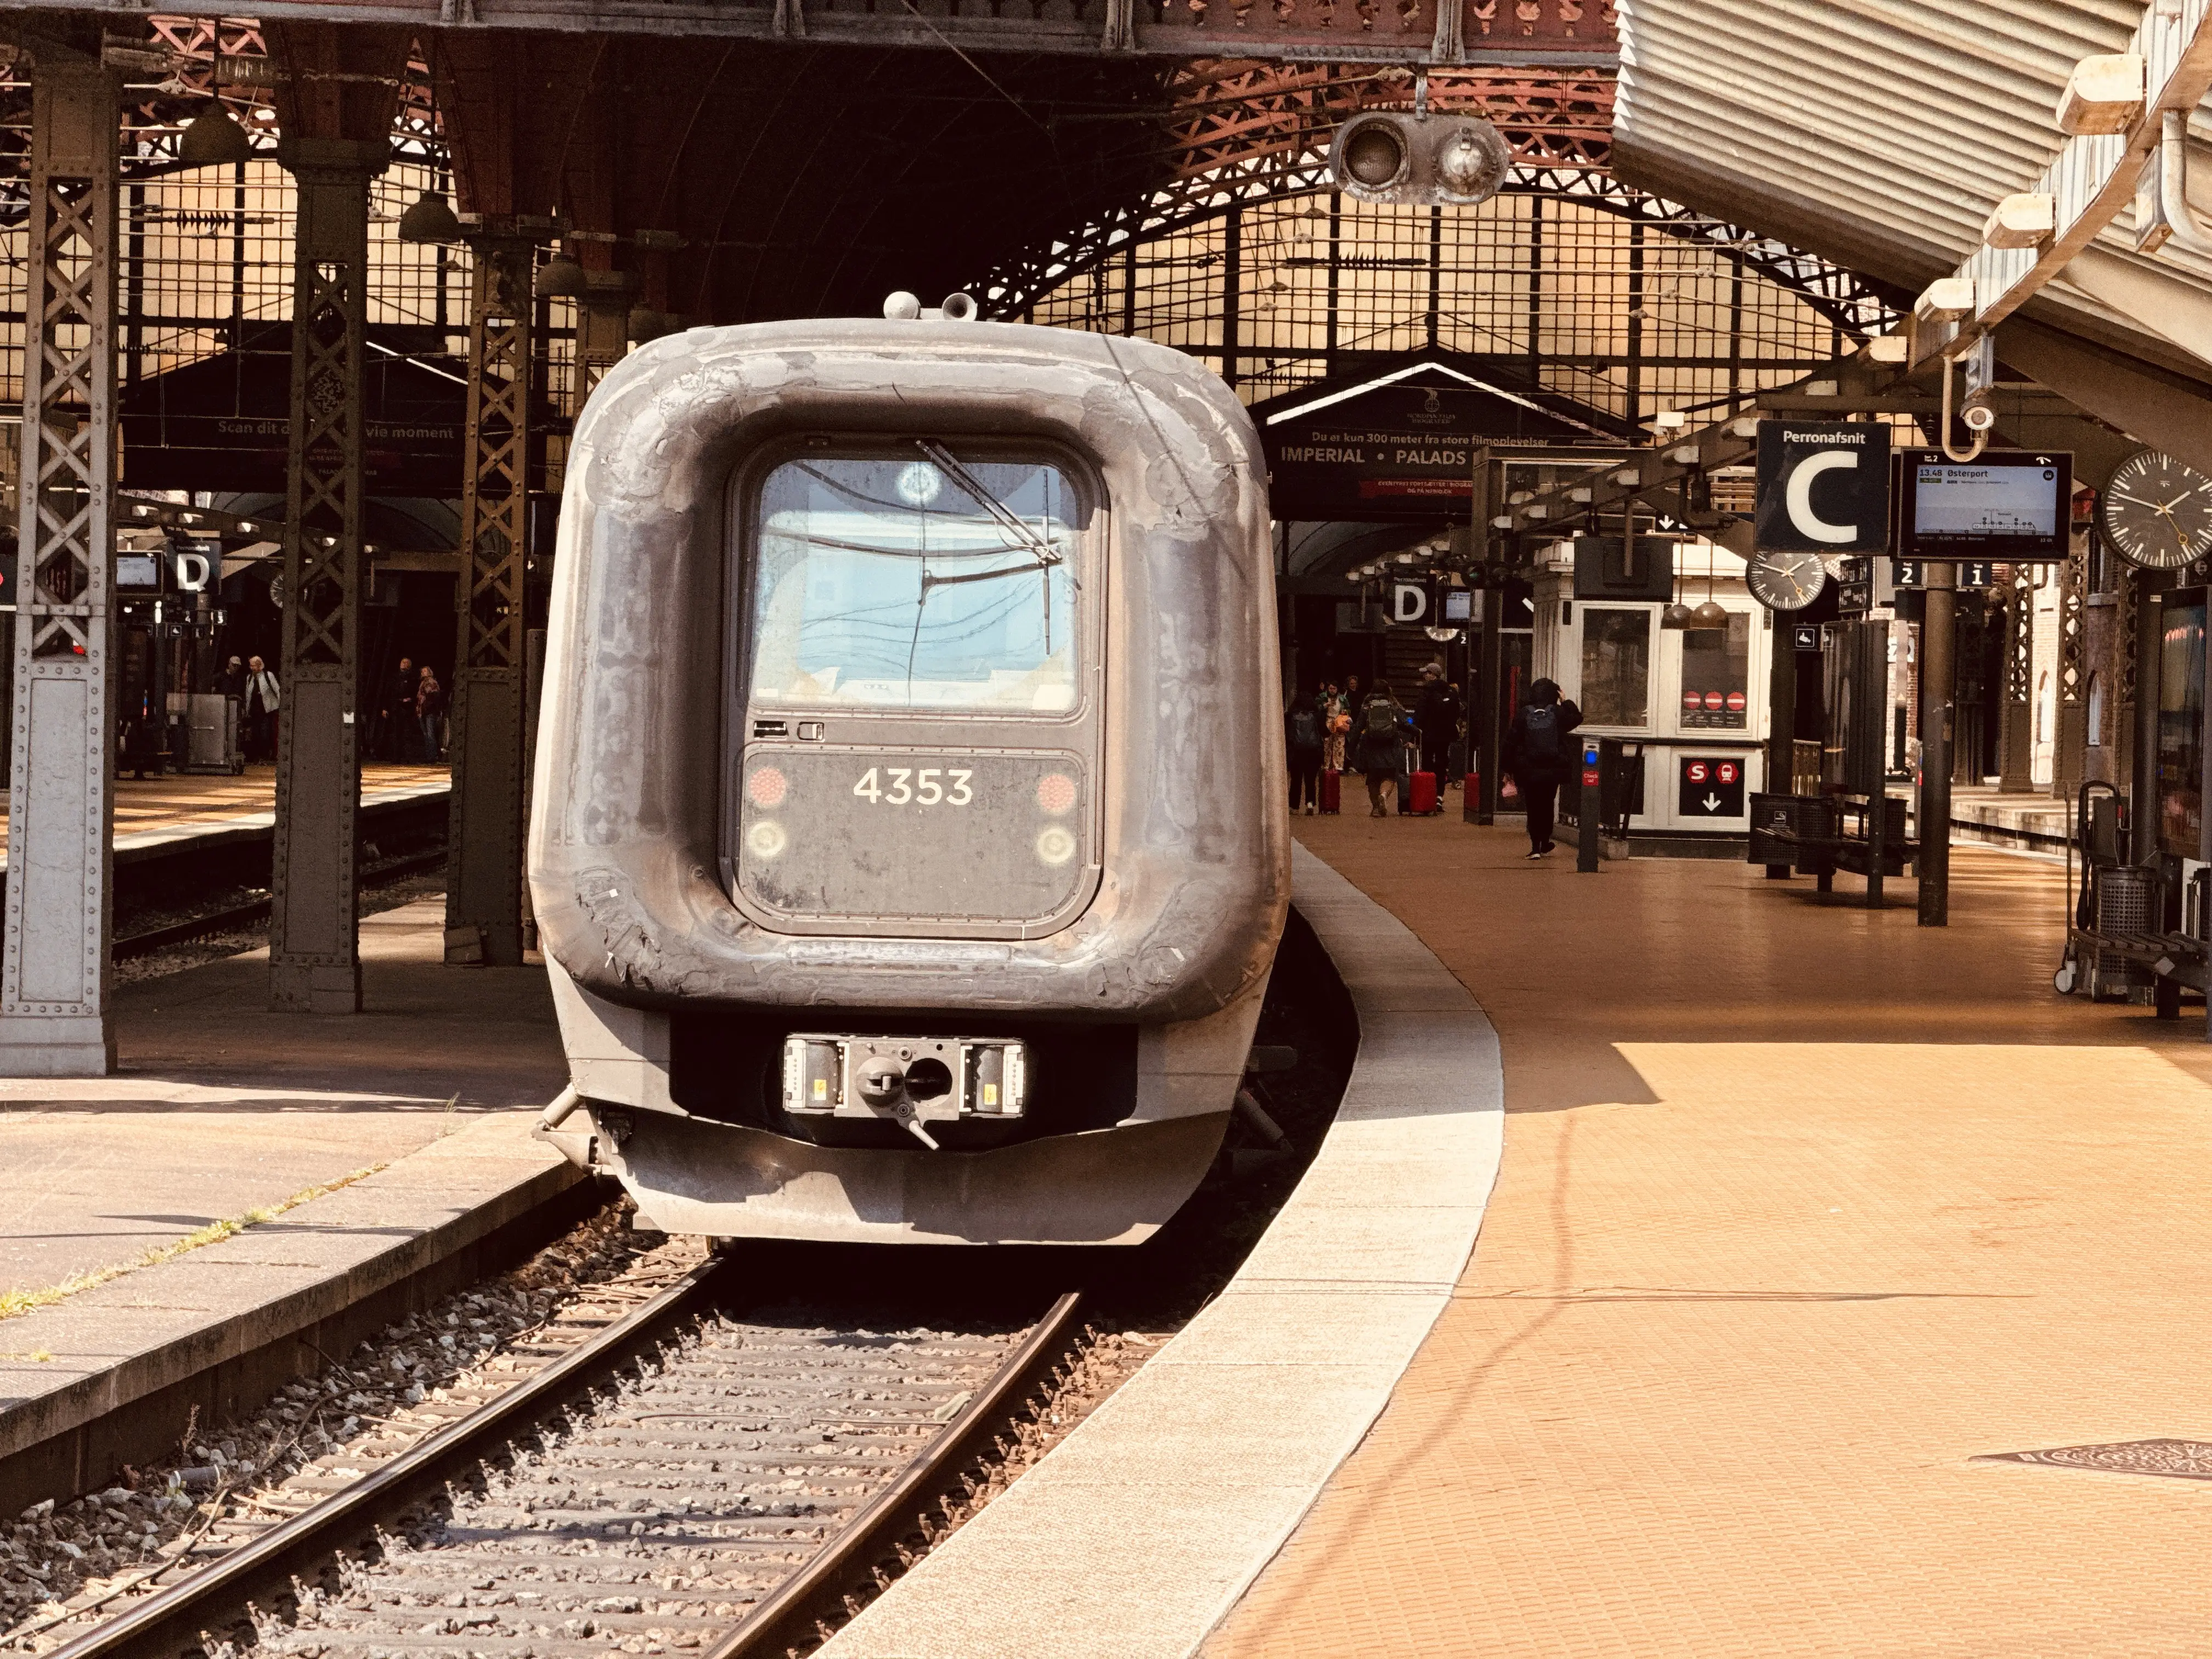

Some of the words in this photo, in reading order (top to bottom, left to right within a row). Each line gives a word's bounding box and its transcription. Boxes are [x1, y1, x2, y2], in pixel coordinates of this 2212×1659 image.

[218, 420, 253, 433] Scan
[256, 420, 278, 435] dit
[392, 427, 454, 439] moment
[1783, 430, 1866, 444] Perronafsnit
[1312, 432, 1327, 441] Du
[1344, 432, 1364, 443] kun
[1367, 433, 1387, 443] 300
[1390, 435, 1422, 444] meter
[1425, 434, 1439, 444] fra
[1442, 435, 1469, 445] store
[1282, 446, 1365, 463] IMPERIAL
[1396, 450, 1466, 465] PALADS
[1948, 470, 1988, 478] Østerport
[1786, 450, 1858, 544] C
[178, 553, 210, 590] D
[1901, 567, 1913, 583] 2
[1972, 569, 1983, 585] 1
[1394, 585, 1426, 621] D
[1691, 765, 1705, 780] S
[853, 768, 973, 805] 4353
